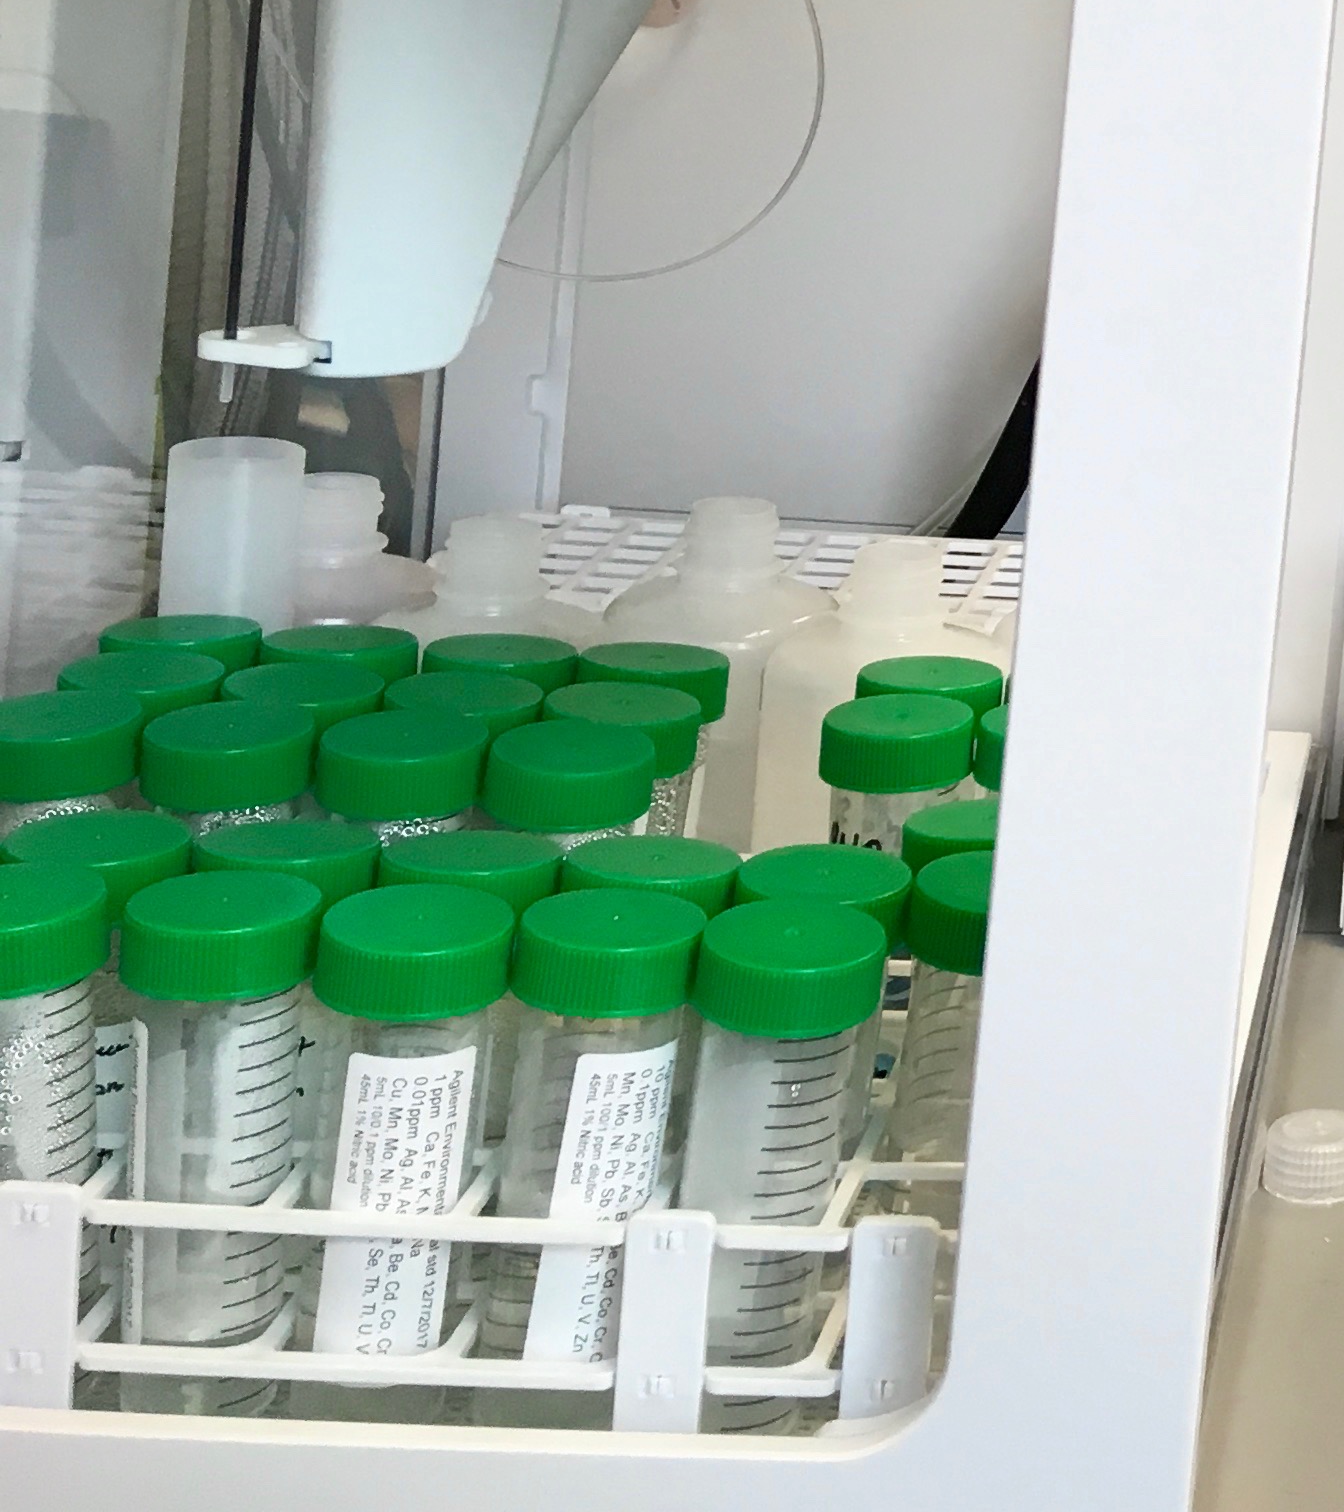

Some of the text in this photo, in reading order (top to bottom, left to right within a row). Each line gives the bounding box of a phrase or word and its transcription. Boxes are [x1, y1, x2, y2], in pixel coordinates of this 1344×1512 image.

[429, 1088, 442, 1118] ppm
[447, 1069, 464, 1120] Agilent
[351, 1129, 364, 1158] Nitric
[576, 1130, 591, 1158] Nitric
[347, 1161, 359, 1184] acid
[571, 1161, 583, 1185] acid
[425, 1255, 437, 1277] std
[573, 1334, 588, 1352] Zn
